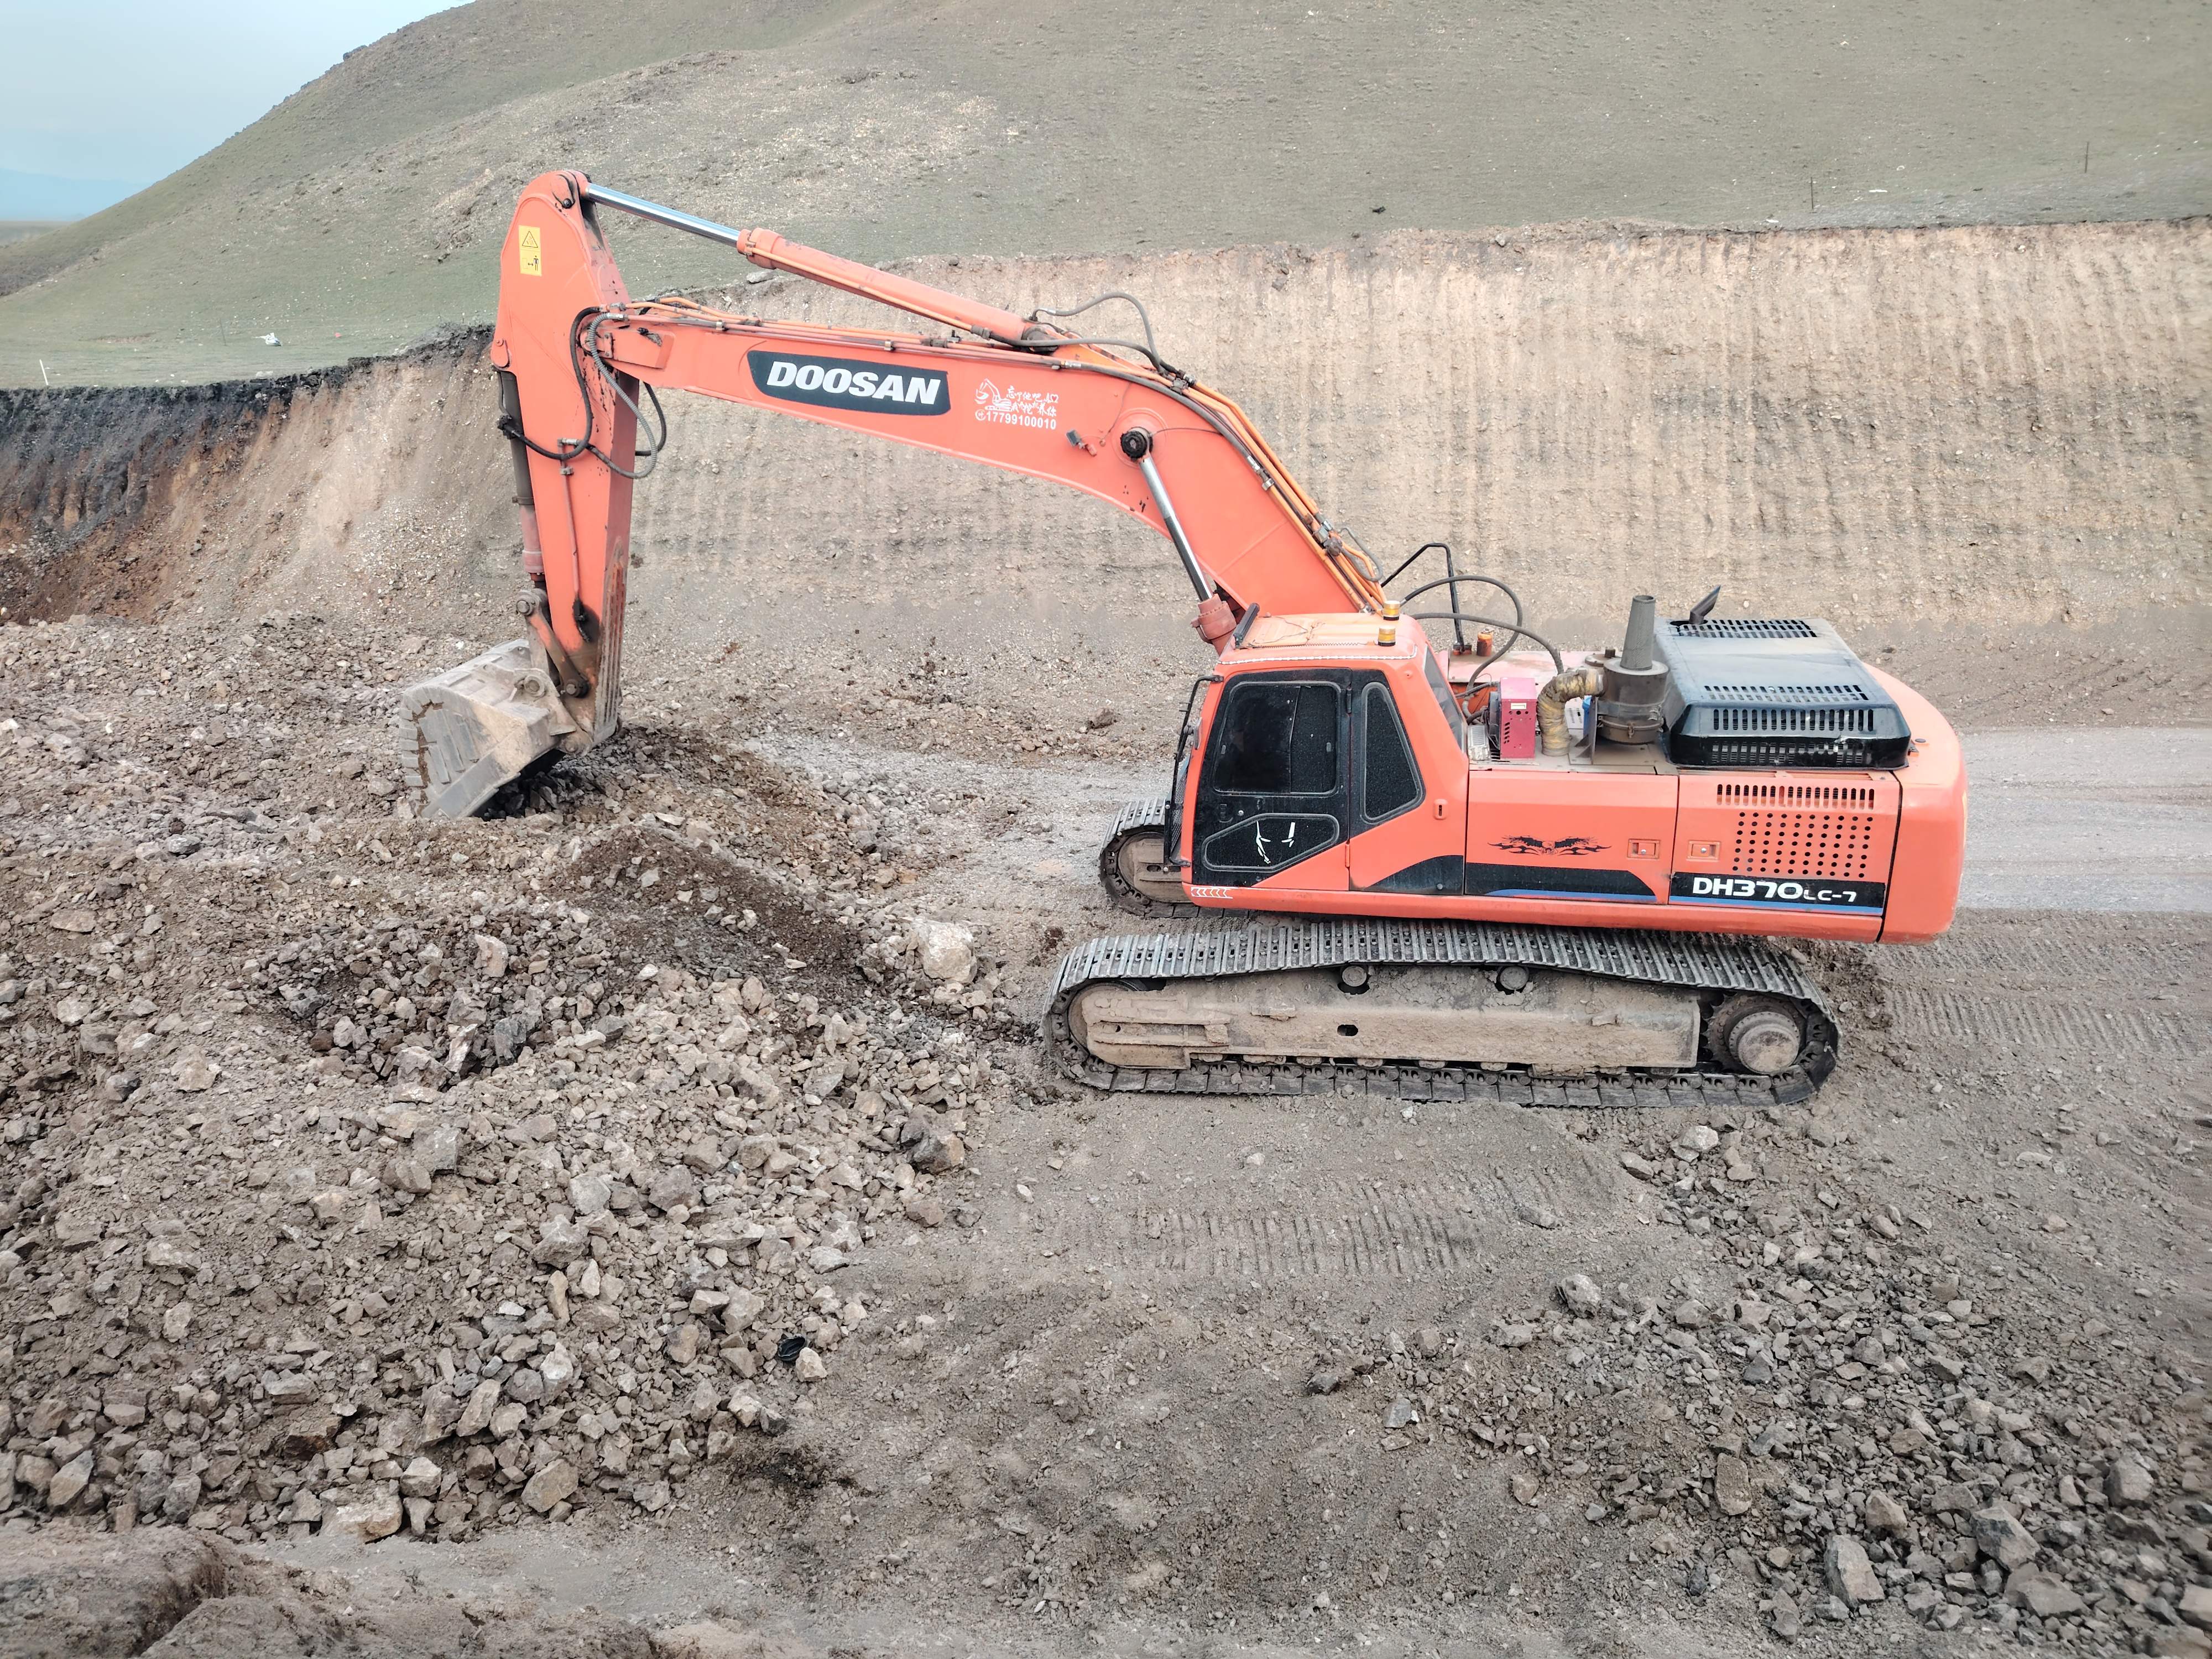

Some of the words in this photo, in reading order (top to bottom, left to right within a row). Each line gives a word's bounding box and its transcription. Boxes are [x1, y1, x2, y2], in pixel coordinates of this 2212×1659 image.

[766, 361, 941, 405] DOOSAN
[986, 411, 1057, 430] 17799100010
[1692, 877, 1857, 902] DH370LC-7
